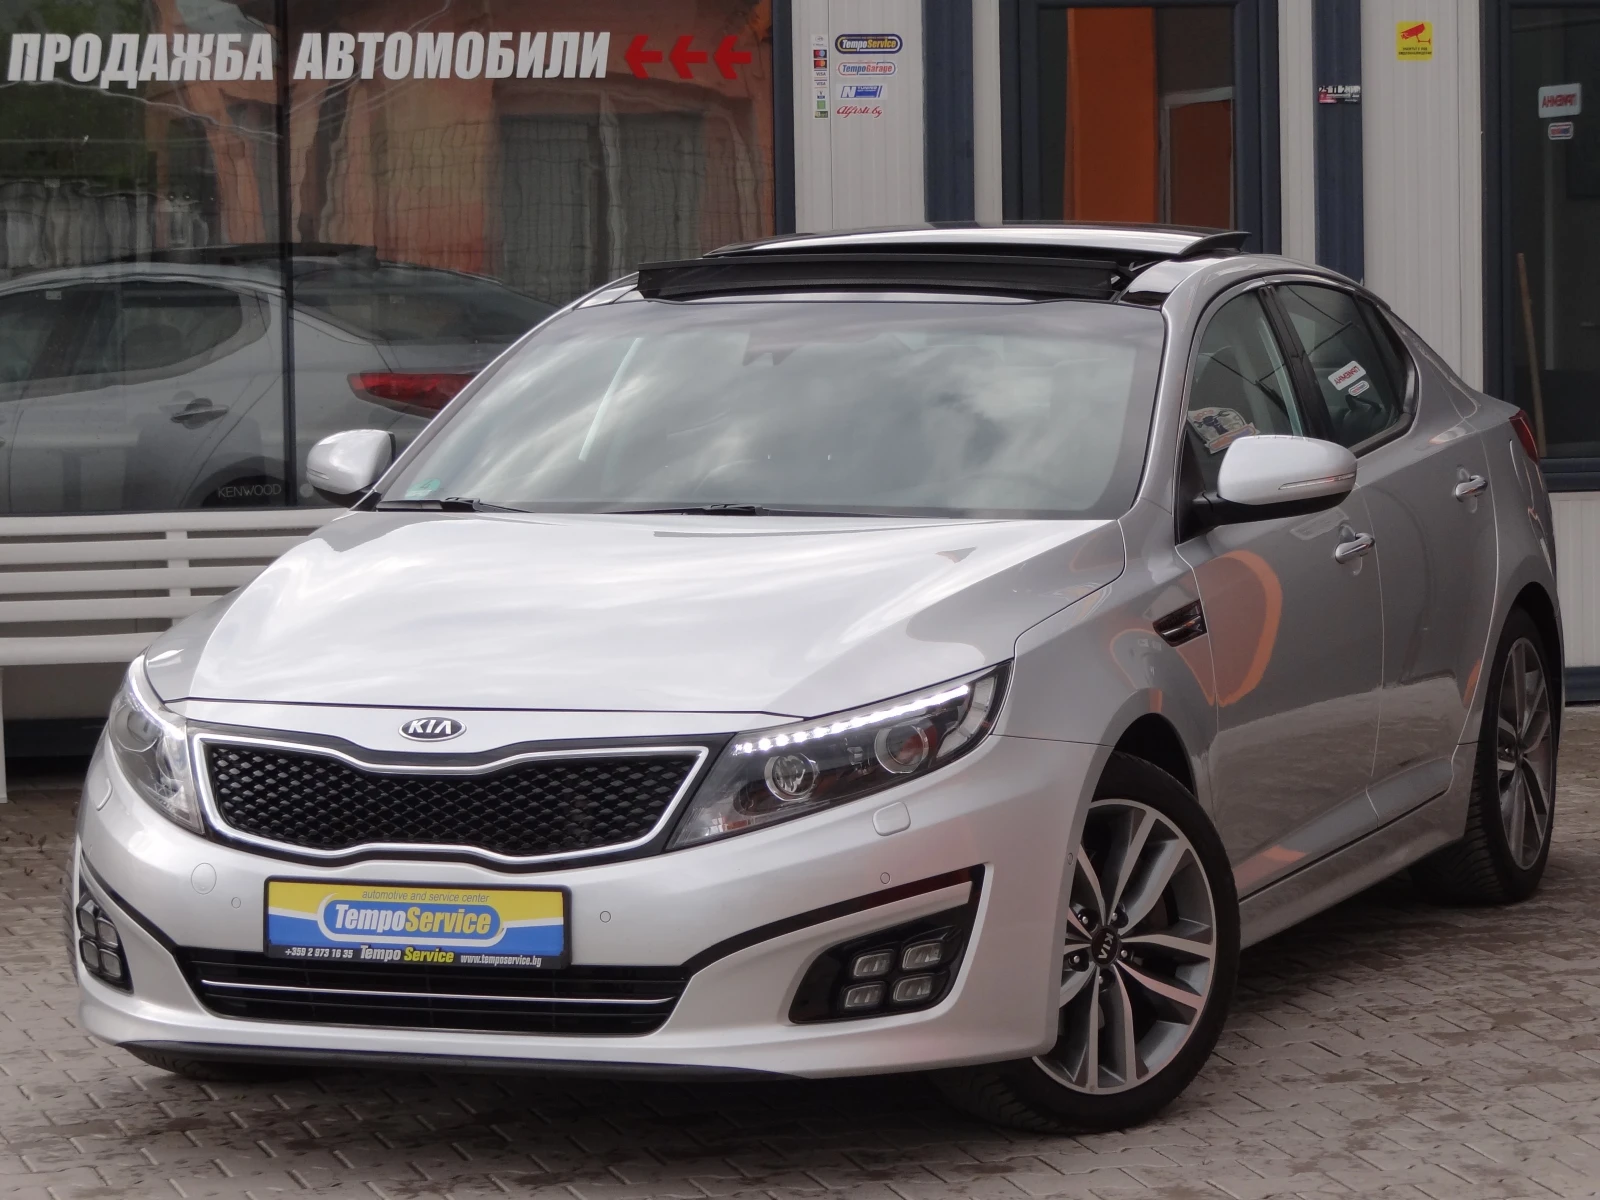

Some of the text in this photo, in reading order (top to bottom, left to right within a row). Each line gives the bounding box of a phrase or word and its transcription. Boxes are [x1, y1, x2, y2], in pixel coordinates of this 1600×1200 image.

[842, 39, 897, 52] TempoService
[7, 32, 611, 89] ПРОДАЖБА АВТОМОБИЛИ
[842, 64, 893, 75] TempoGarage
[217, 484, 282, 499] KENWOOD
[408, 719, 452, 735] KIA
[362, 890, 490, 903] automotive and service center
[335, 904, 492, 934] TempoService
[1098, 932, 1114, 959] KIA
[285, 944, 542, 967] +359 2 973 16 35 Tempo Service www.temposervice.bg
